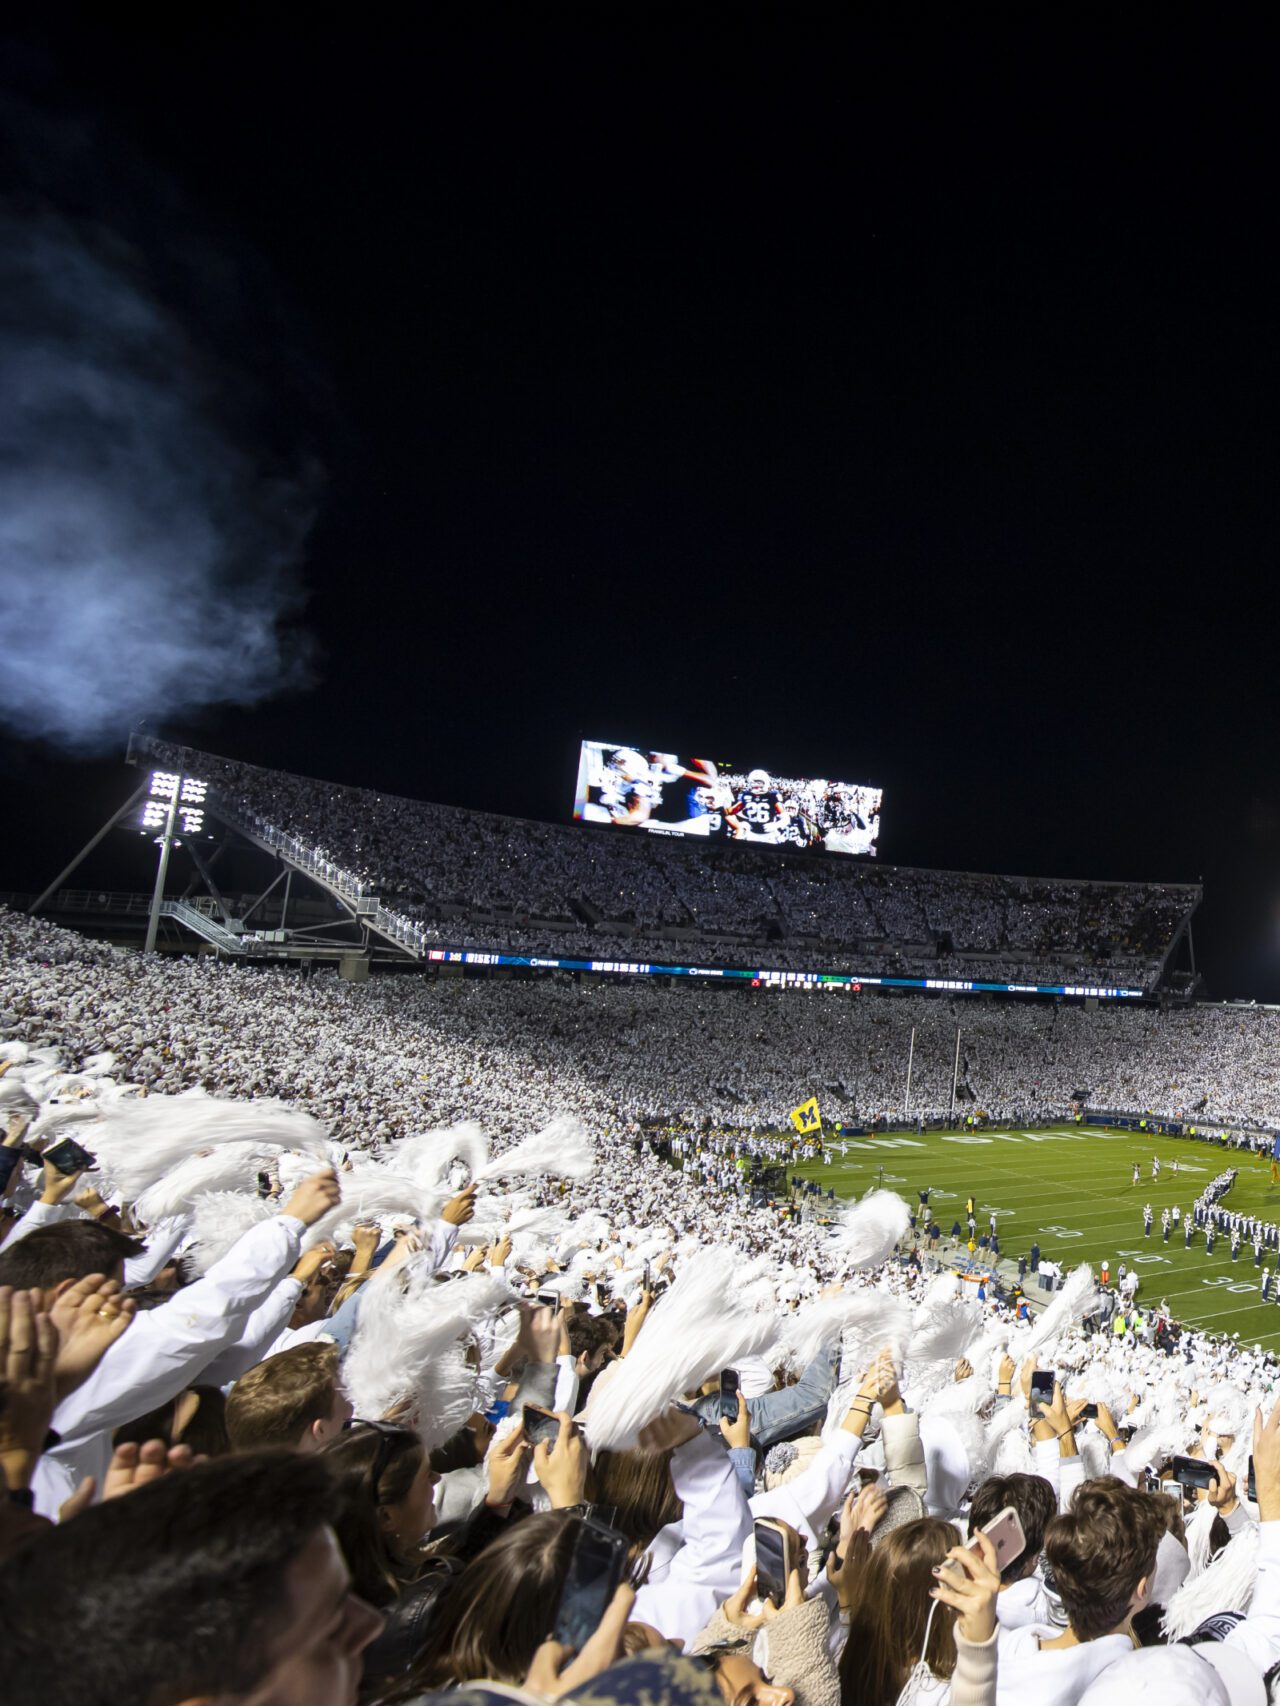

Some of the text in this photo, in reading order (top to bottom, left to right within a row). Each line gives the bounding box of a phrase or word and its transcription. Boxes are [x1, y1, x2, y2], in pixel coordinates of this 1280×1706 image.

[745, 802, 771, 823] 26
[799, 1105, 818, 1129] M
[941, 1131, 1129, 1144] STATE
[1038, 1225, 1084, 1238] 50
[1116, 1250, 1164, 1264] 40
[1202, 1276, 1260, 1293] 30
